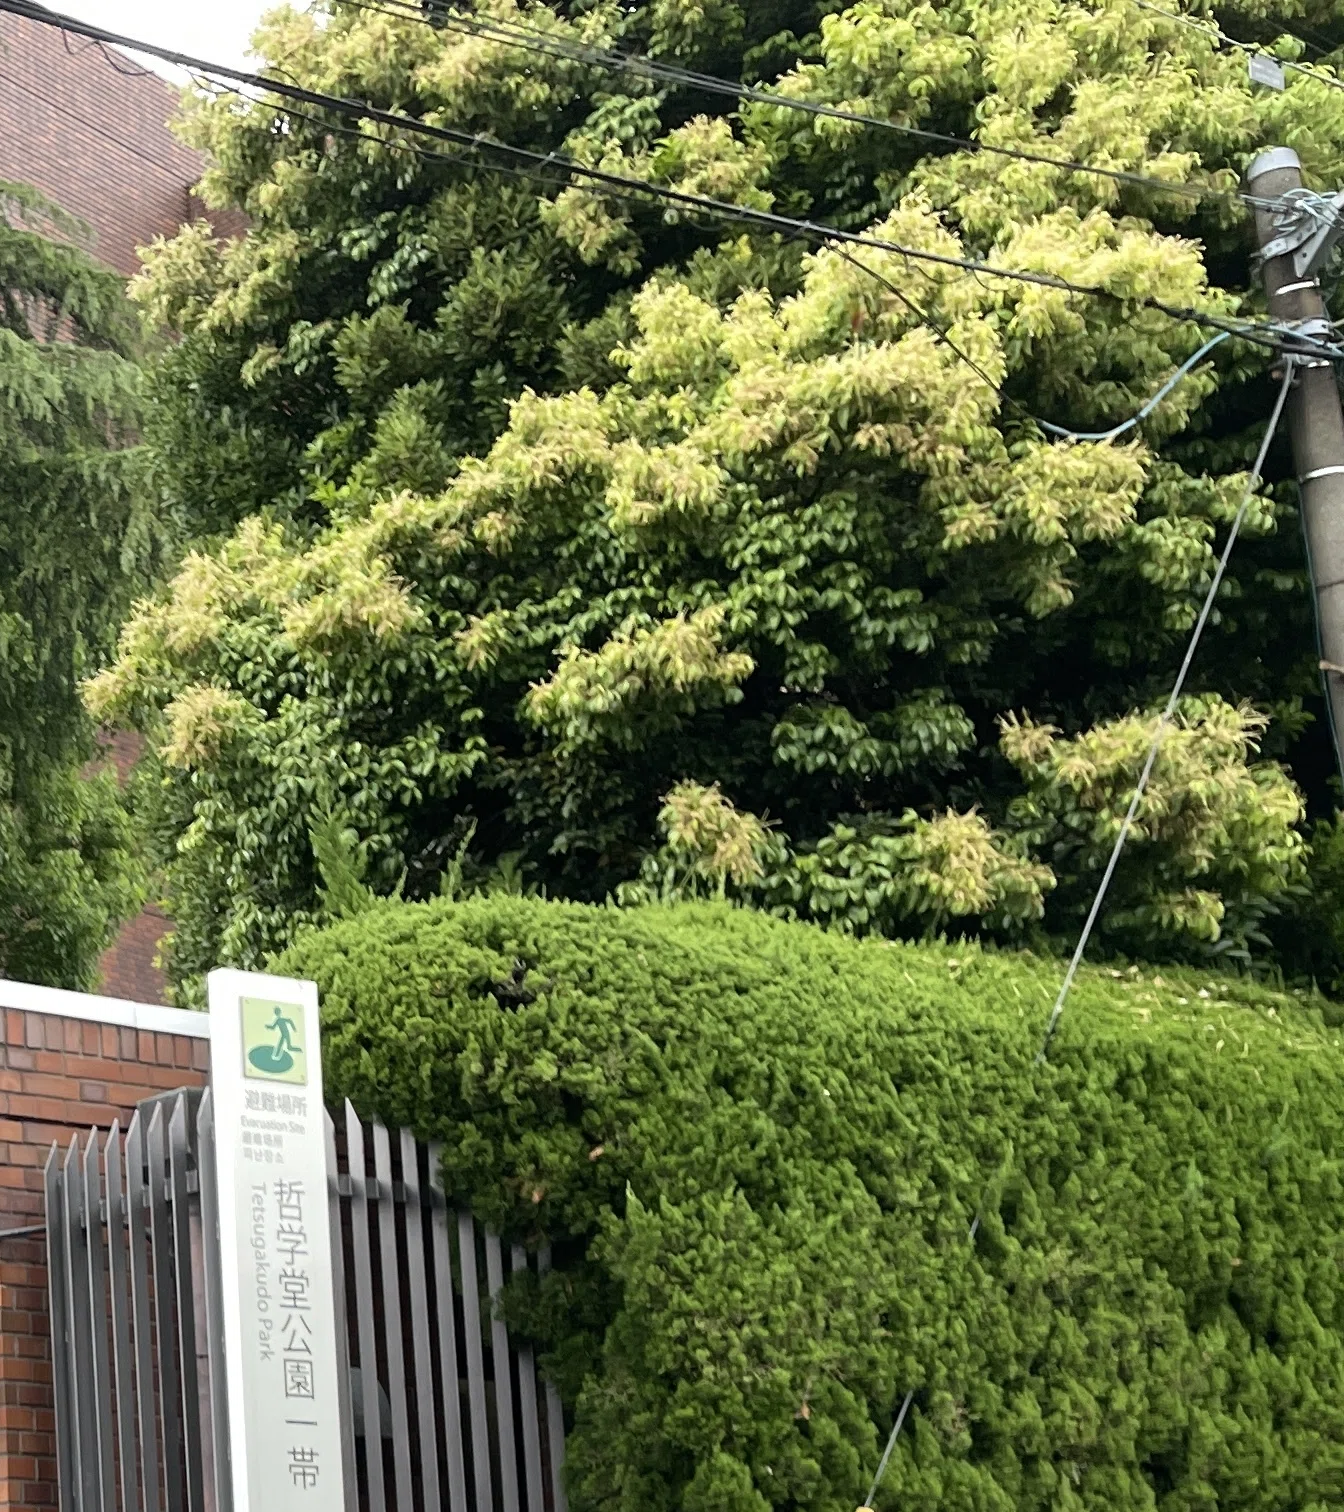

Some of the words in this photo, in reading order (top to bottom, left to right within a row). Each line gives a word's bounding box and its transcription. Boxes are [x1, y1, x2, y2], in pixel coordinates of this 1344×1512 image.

[250, 1181, 272, 1313] Tetsugakudo
[257, 1317, 275, 1362] Park
[273, 1178, 320, 1490] 哲学堂公園一帯
